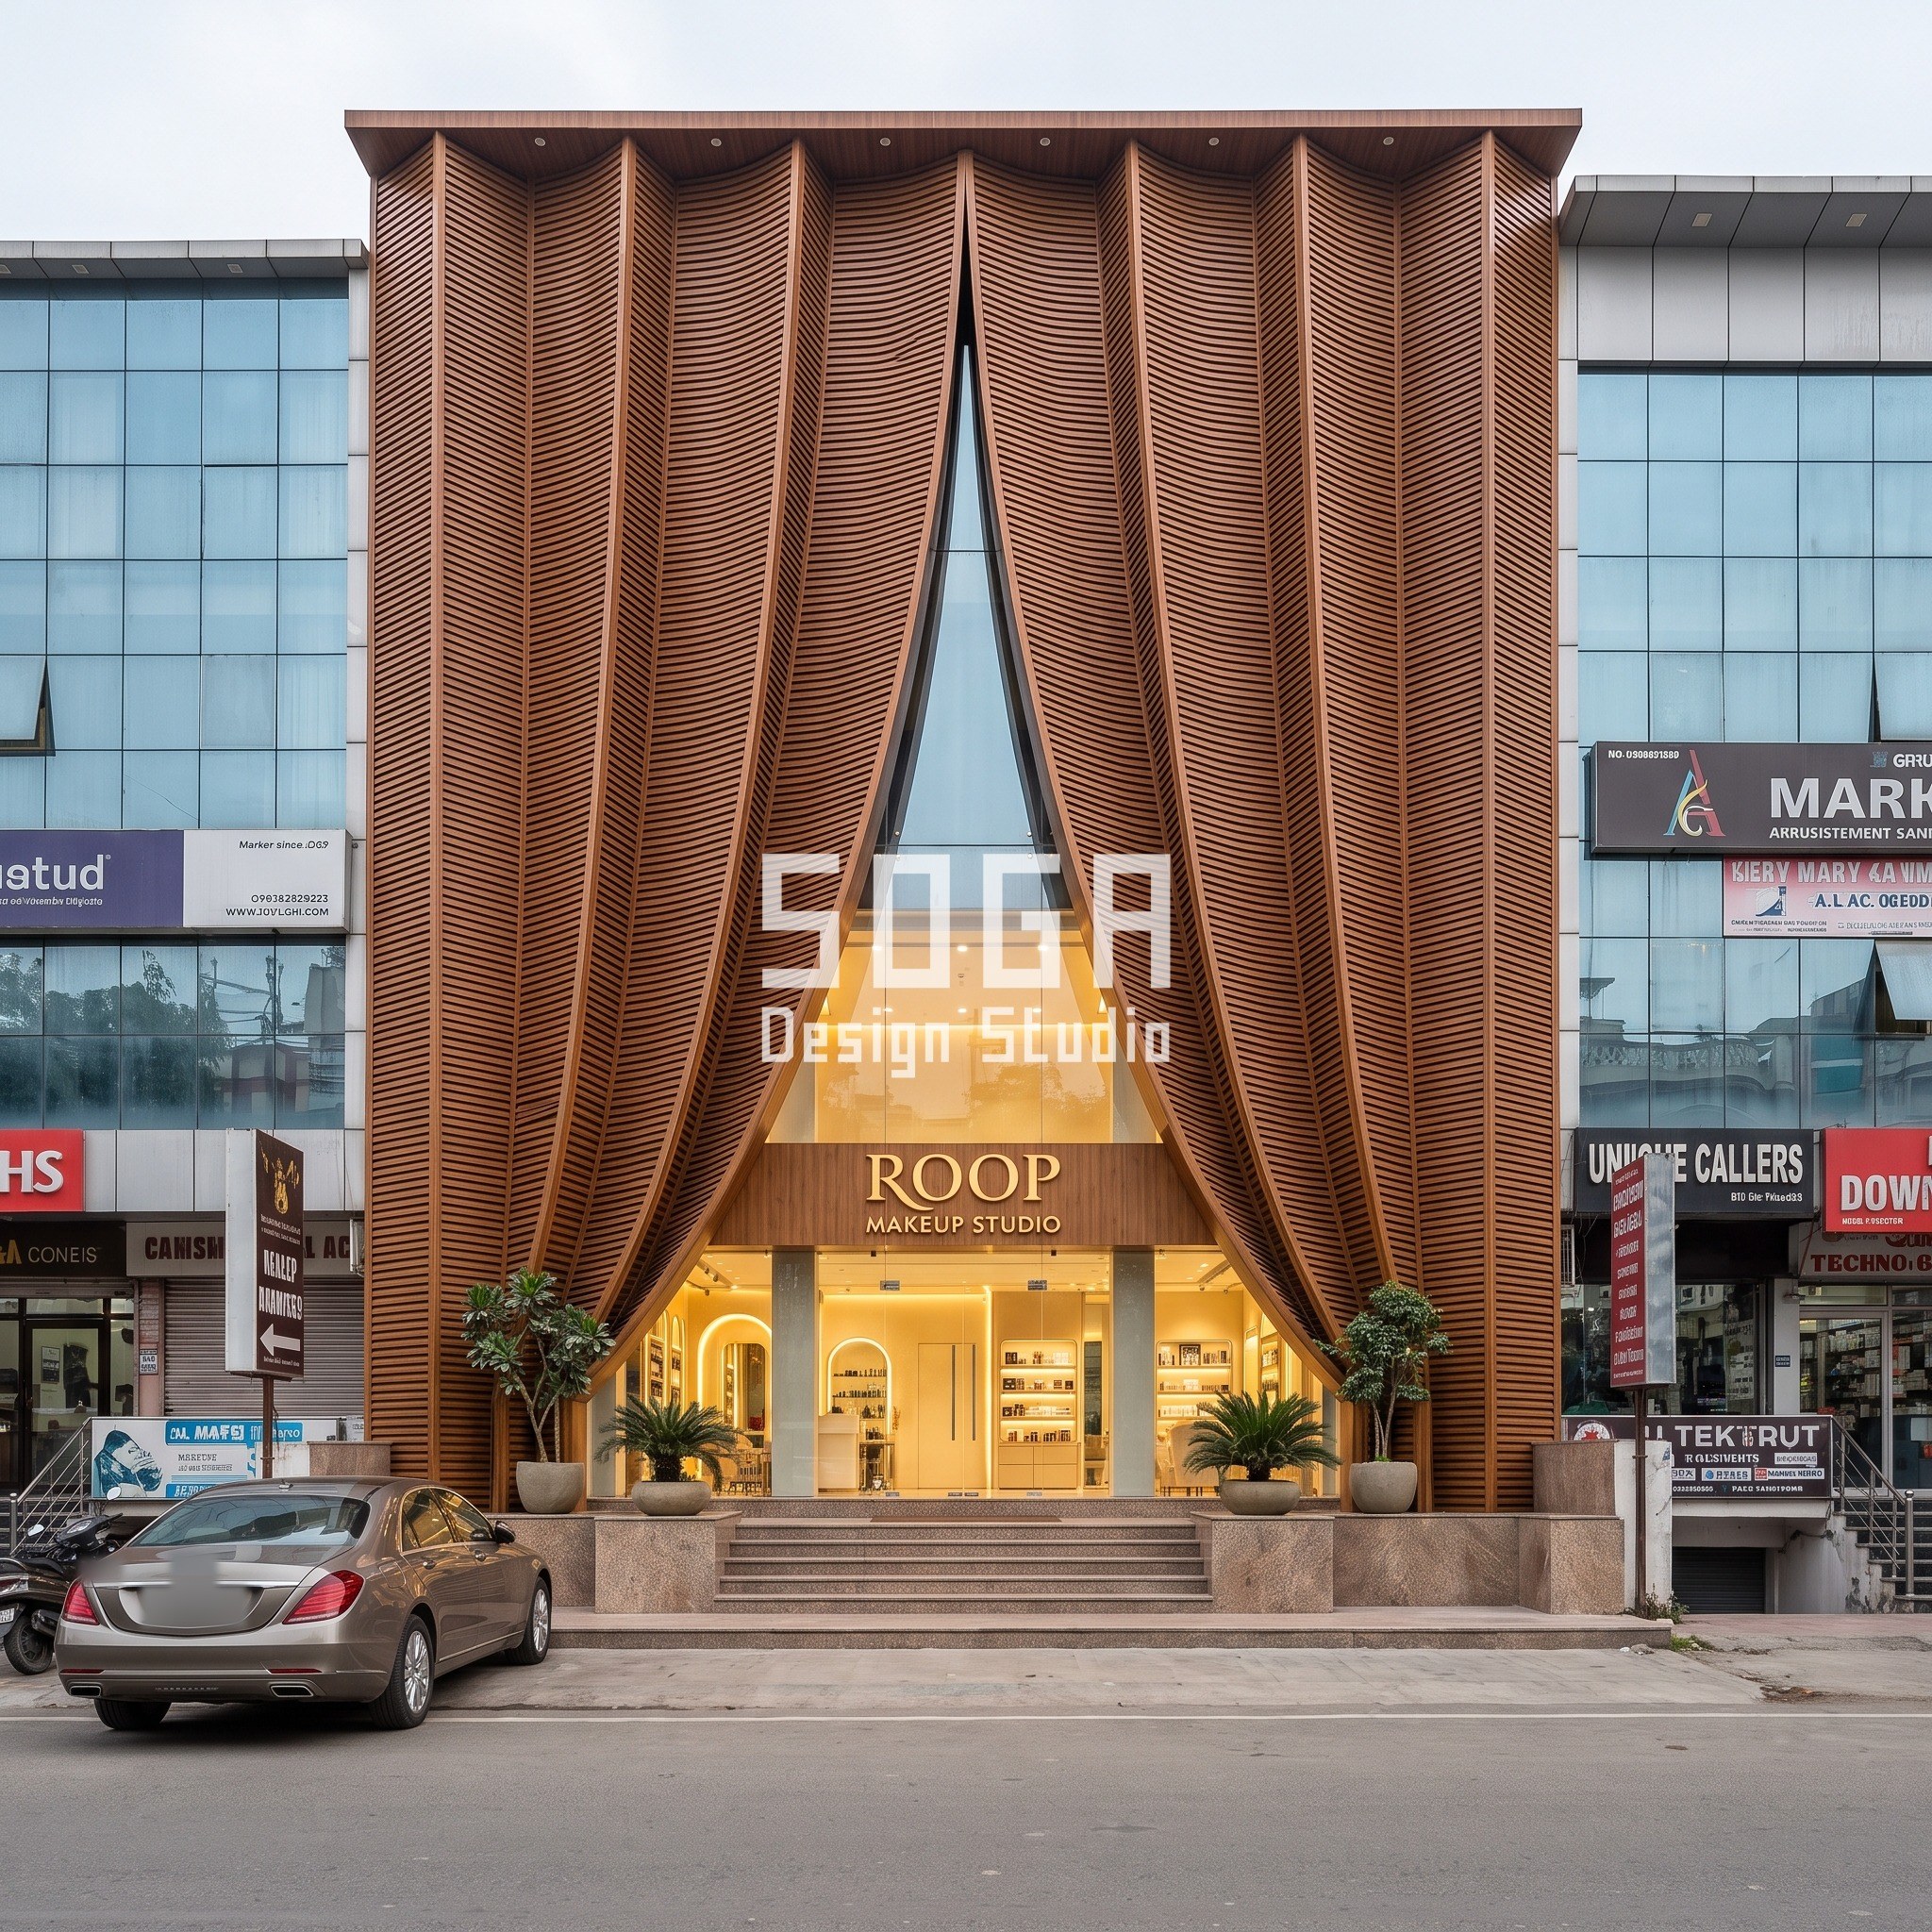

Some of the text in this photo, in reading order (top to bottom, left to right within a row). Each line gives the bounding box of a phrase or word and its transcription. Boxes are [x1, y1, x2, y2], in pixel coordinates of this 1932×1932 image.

[239, 841, 274, 849] Marker
[0, 854, 104, 891] atud
[1797, 862, 1861, 883] MARY
[1695, 1143, 1804, 1184] CALLERS
[865, 1153, 1061, 1211] ROOP
[865, 1216, 1061, 1234] MAKEUP STUDIO
[1810, 1254, 1907, 1273] TECHNO
